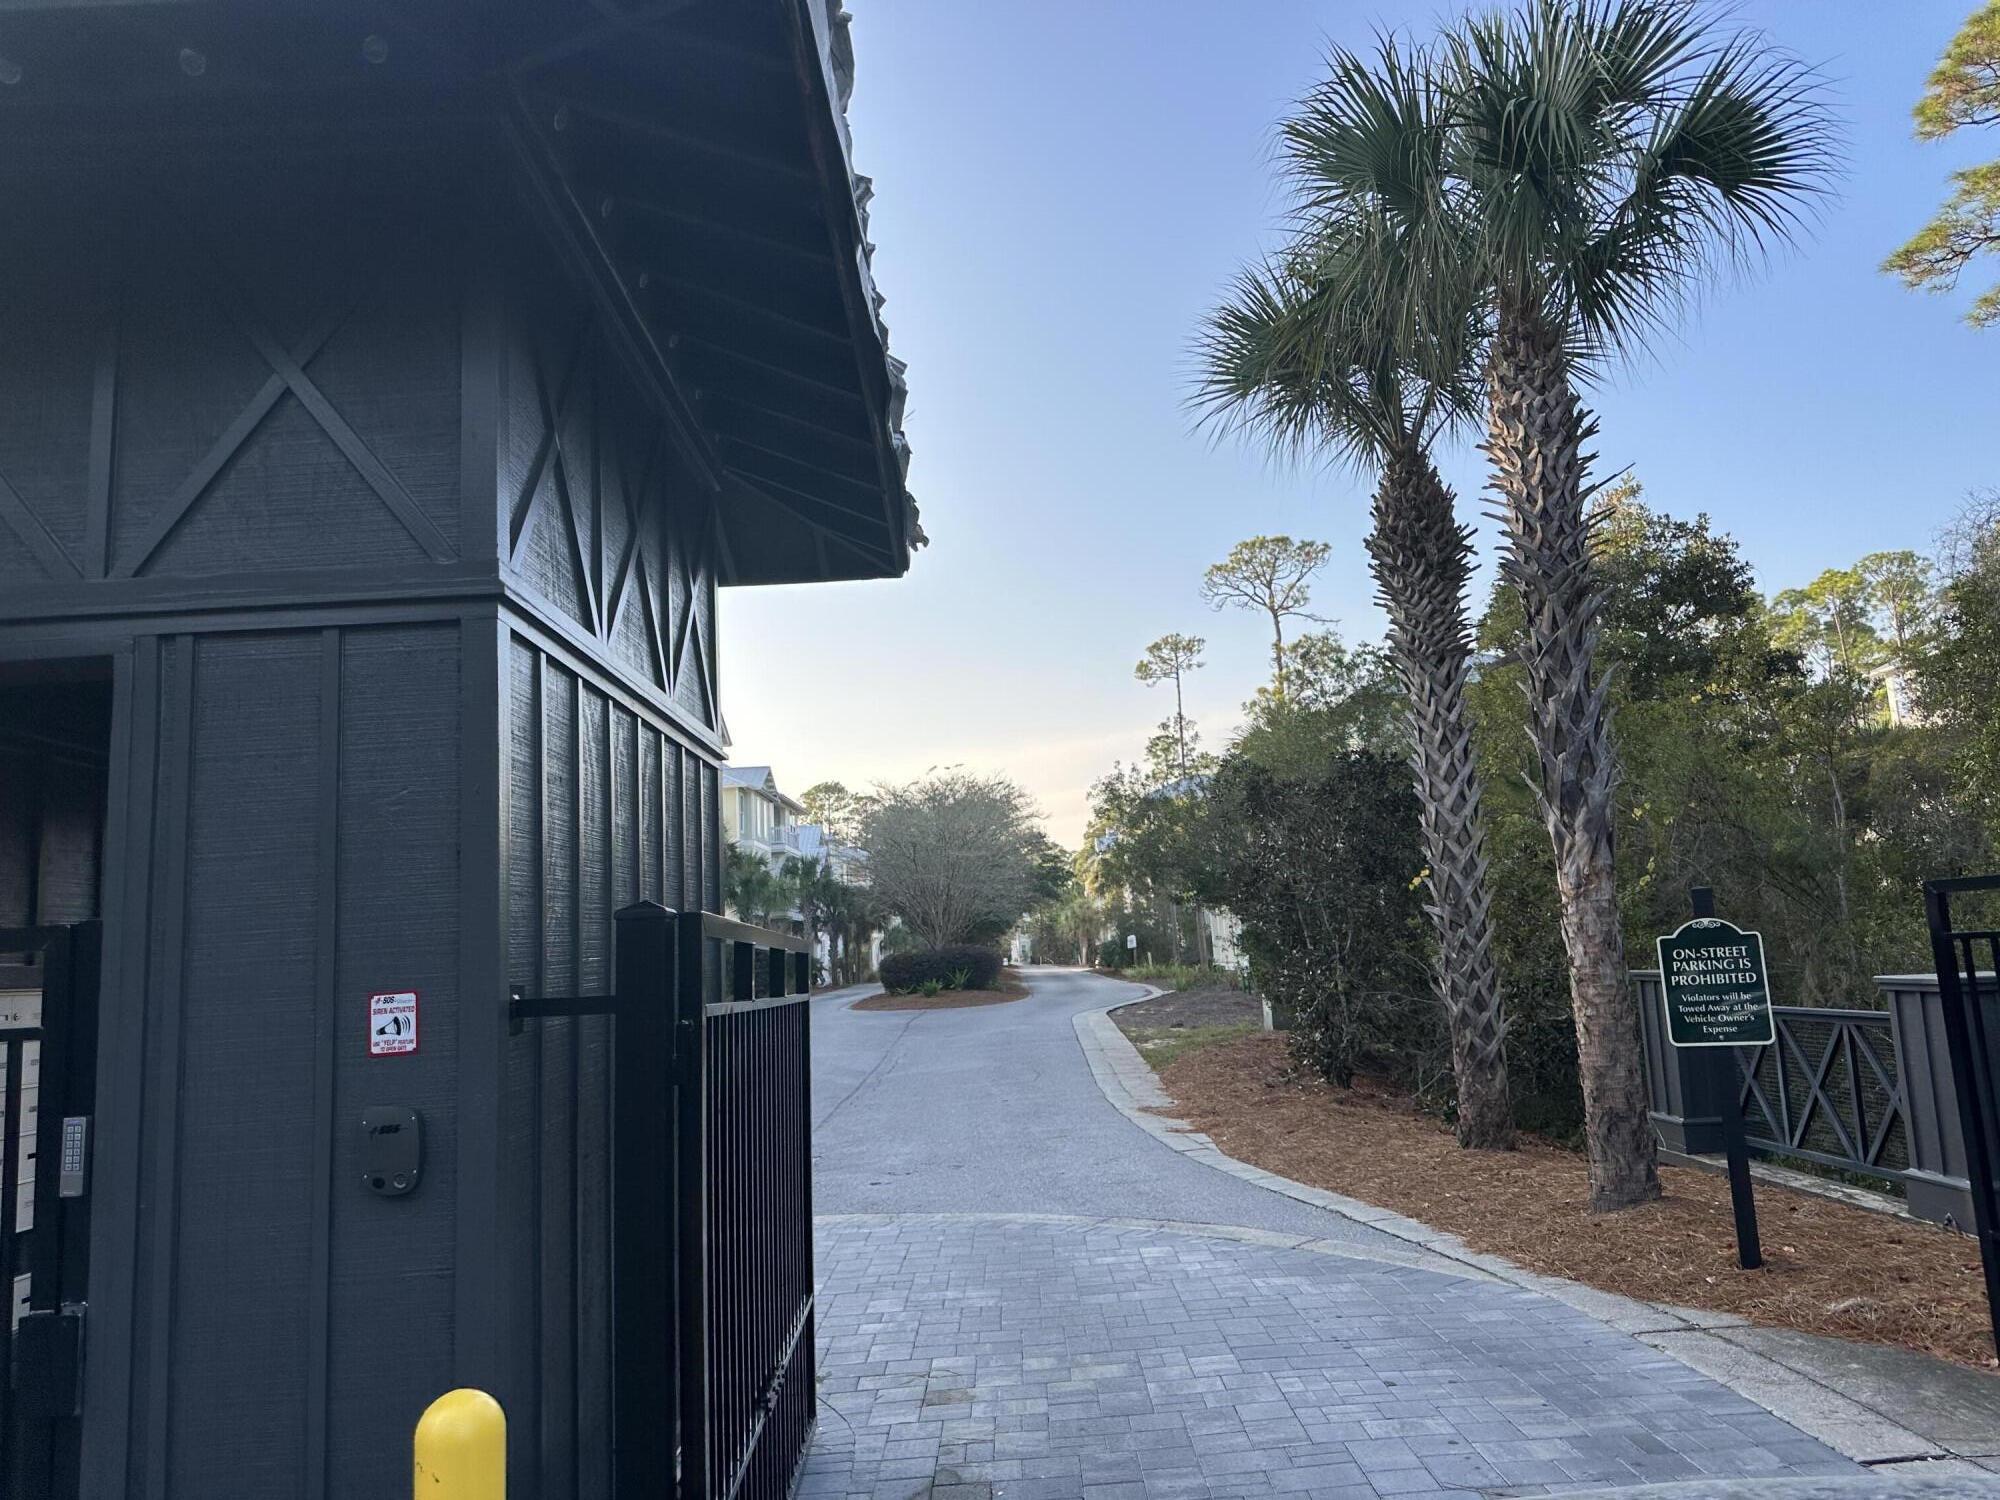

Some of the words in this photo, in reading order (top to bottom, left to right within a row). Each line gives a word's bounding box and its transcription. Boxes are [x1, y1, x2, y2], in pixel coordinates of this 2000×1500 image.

[1672, 946, 1748, 959] ON-STREET
[1672, 958, 1735, 972] PARKING
[1739, 958, 1751, 969] IS
[1671, 972, 1757, 986] PROHIBITED
[1681, 993, 1720, 1002] Violators
[1722, 992, 1738, 1001] will
[1740, 991, 1752, 1000] be
[373, 1007, 388, 1015] SIREN
[389, 1005, 415, 1014] ACTIVATED
[1678, 1004, 1705, 1013] Towed
[1707, 1004, 1730, 1013] Away
[1733, 1003, 1741, 1011] at
[1744, 1002, 1759, 1011] the
[1684, 1014, 1716, 1023] Vehicle
[1718, 1013, 1755, 1022] Owner's
[1703, 1025, 1738, 1035] Expense
